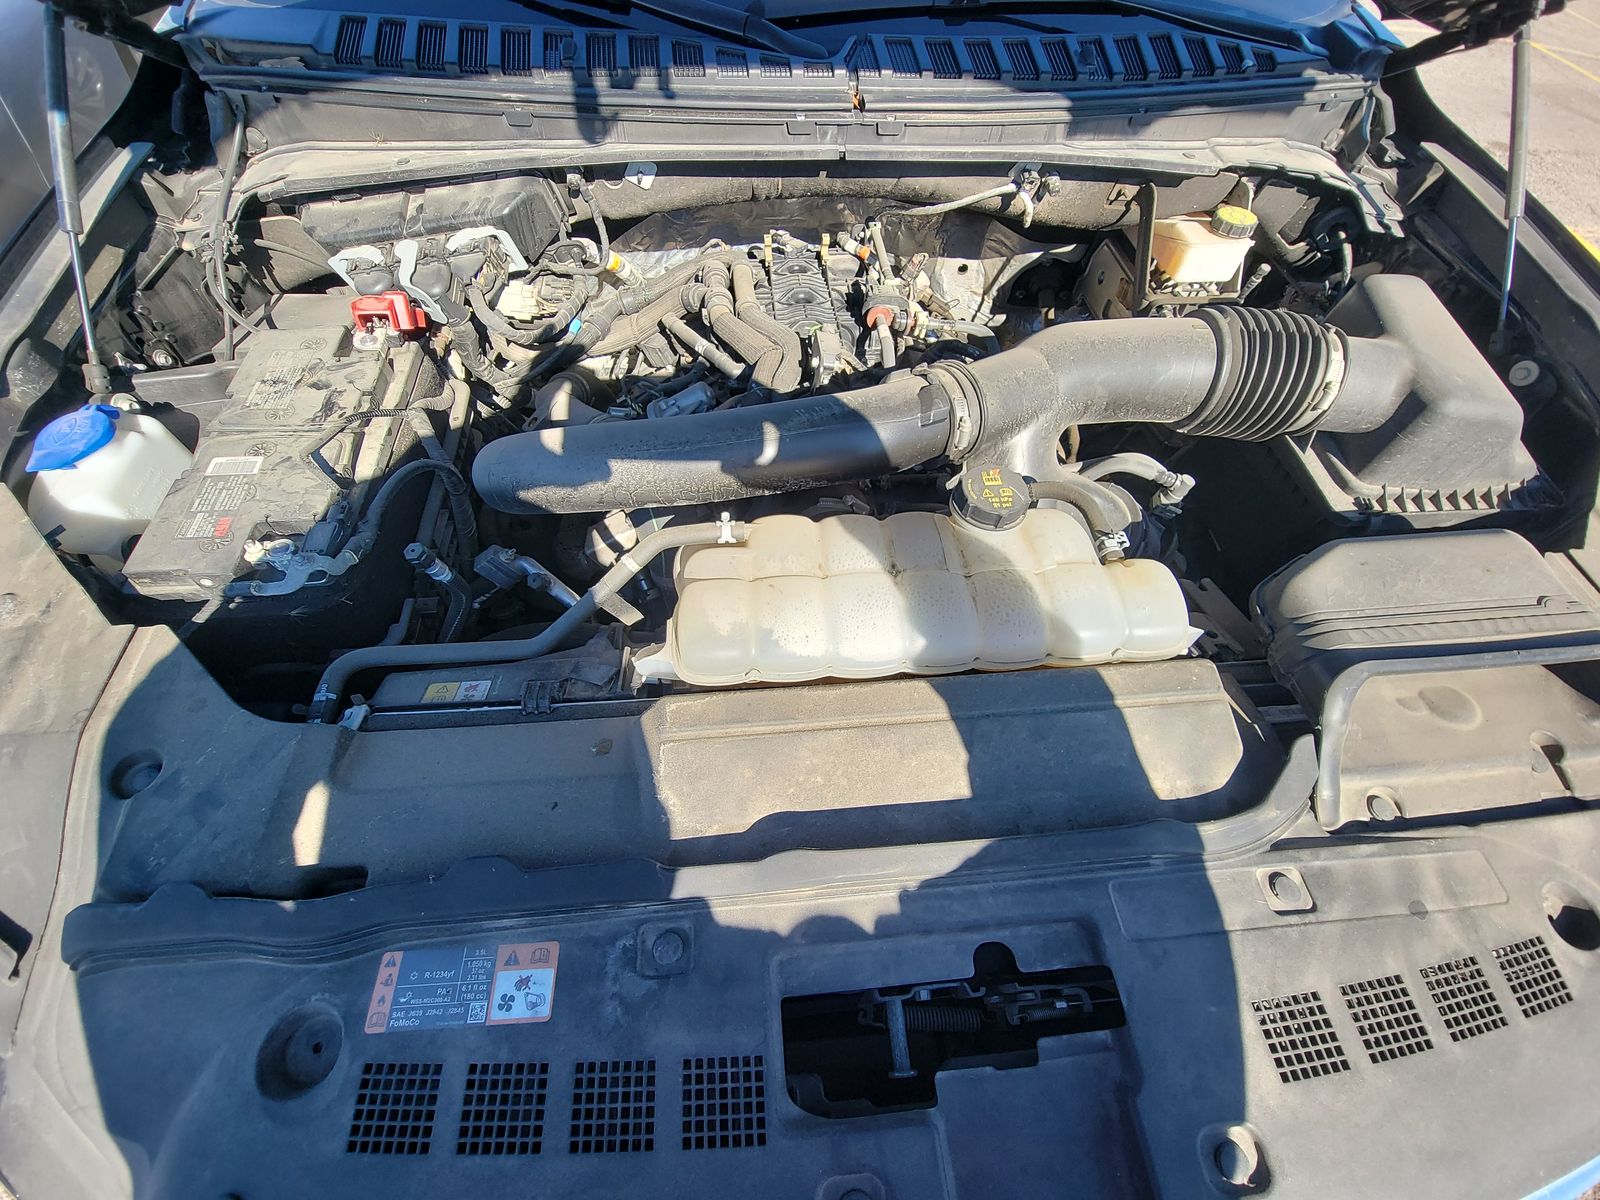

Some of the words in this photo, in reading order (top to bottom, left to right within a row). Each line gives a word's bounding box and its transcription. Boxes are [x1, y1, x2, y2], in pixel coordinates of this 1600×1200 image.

[483, 960, 492, 968] kg
[424, 970, 455, 979] R-1234yf
[475, 992, 487, 1000] cc)
[392, 1010, 406, 1018] SAE
[389, 1018, 420, 1028] FoMoCo
